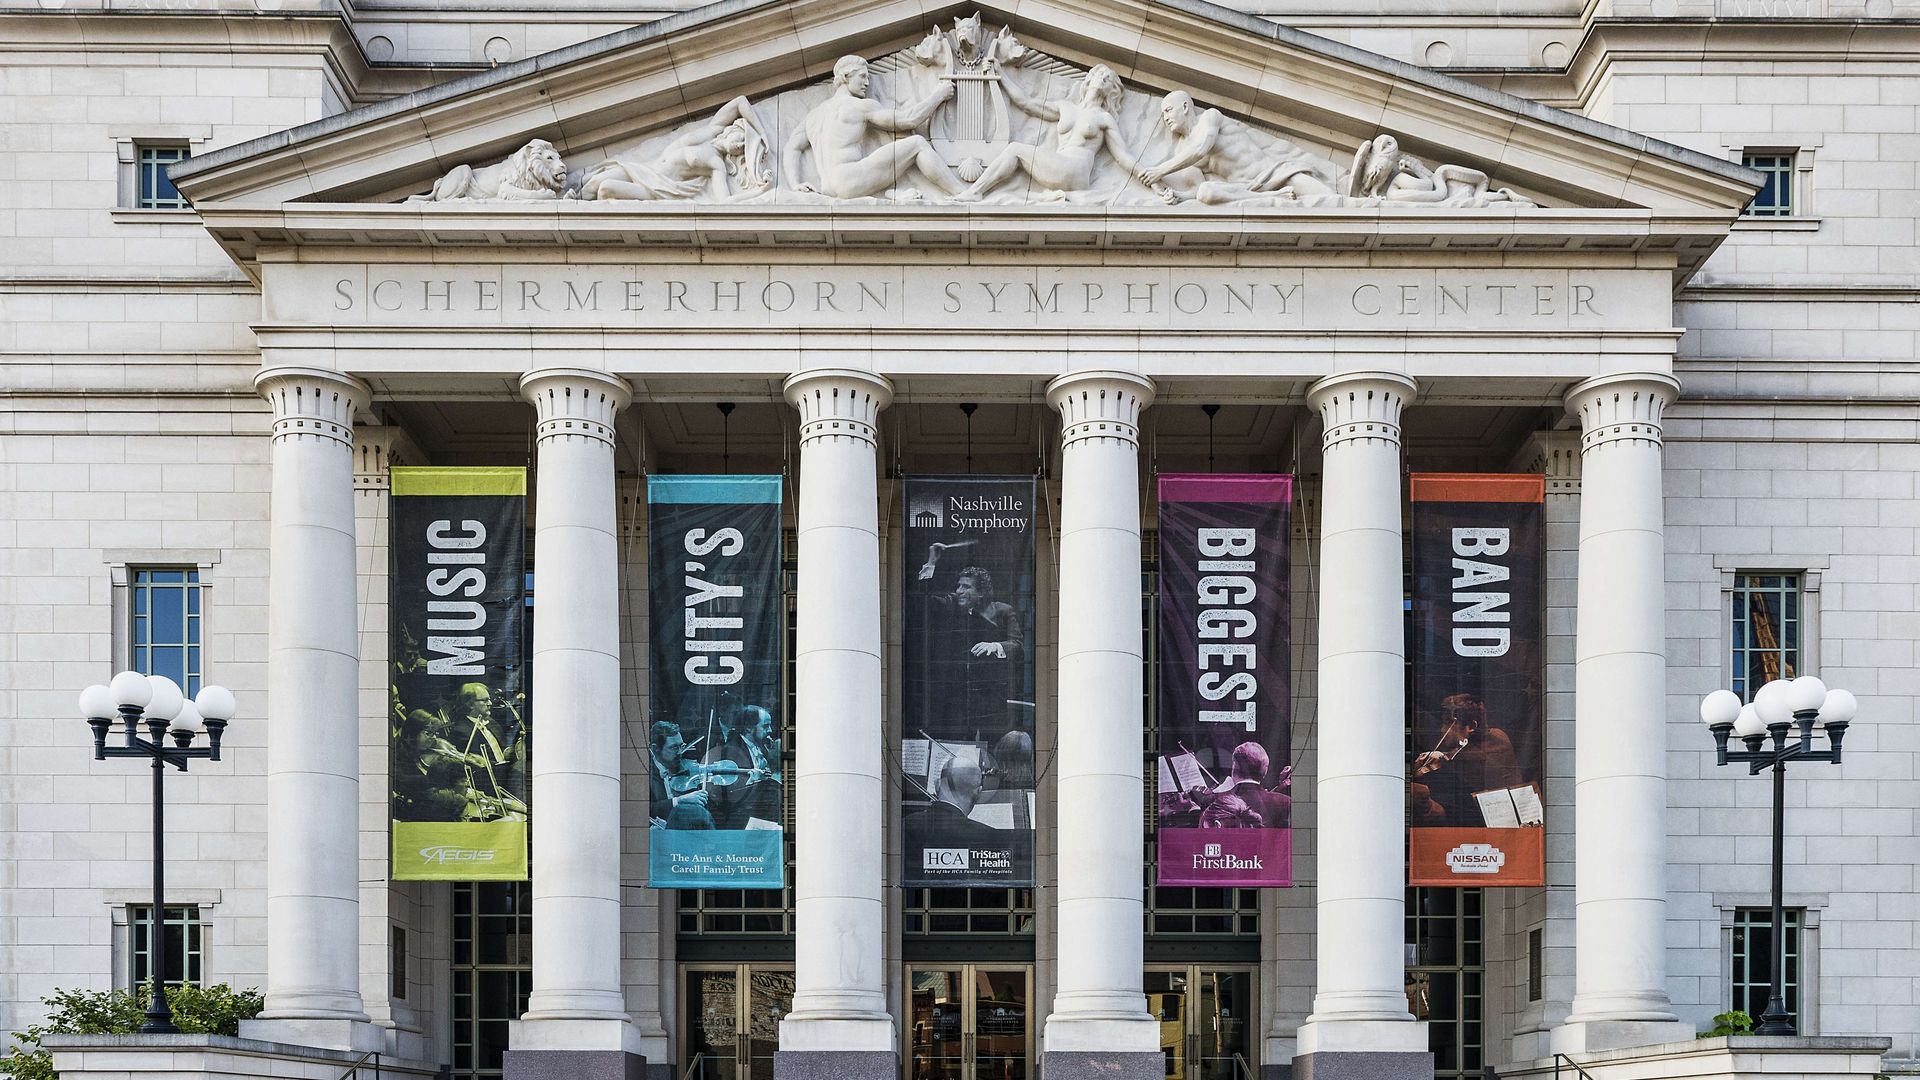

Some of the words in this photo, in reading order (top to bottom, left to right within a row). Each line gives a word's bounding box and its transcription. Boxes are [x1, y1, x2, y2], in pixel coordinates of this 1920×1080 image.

[334, 279, 889, 312] SCHERMERHORN
[943, 281, 1304, 315] SYMPHONY
[1352, 283, 1605, 317] CENTER
[950, 495, 1023, 511] Nashville
[950, 513, 1028, 533] Symphony
[426, 519, 487, 675] MUSIC
[1452, 527, 1510, 657] BAND
[684, 527, 744, 685] CITY'S
[1197, 528, 1257, 732] BIGGEST
[419, 845, 496, 865] AEGIS
[970, 850, 1001, 859] TriStar
[1207, 845, 1220, 855] FB
[670, 853, 689, 862] The
[692, 854, 712, 862] Ann
[715, 854, 723, 862] &
[726, 854, 764, 863] Monroe
[927, 852, 964, 865] HCA
[980, 859, 1010, 868] Health
[1193, 854, 1263, 869] FirstBank
[1453, 855, 1498, 863] NISSAN
[671, 865, 700, 873] Carell
[703, 865, 736, 875] Family
[738, 865, 764, 874] Trust
